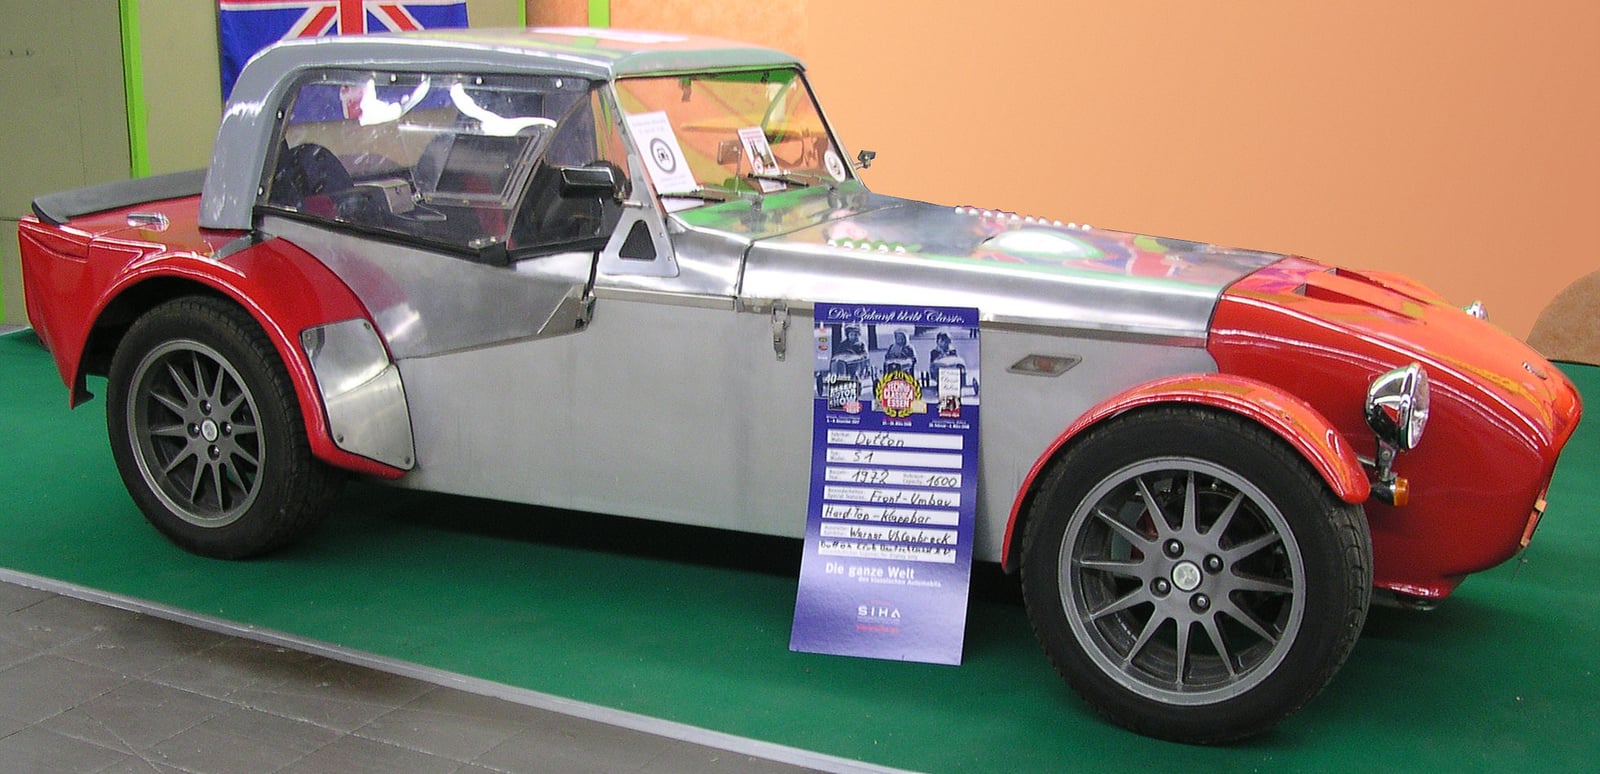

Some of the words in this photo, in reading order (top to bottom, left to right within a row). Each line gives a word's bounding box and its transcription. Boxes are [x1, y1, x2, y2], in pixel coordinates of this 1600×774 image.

[827, 307, 850, 320] Die
[854, 307, 894, 323] Zukunft
[897, 311, 922, 321] bleibt
[924, 310, 965, 324] Classic.
[887, 398, 911, 409] ESSEN
[855, 431, 905, 448] Dutton
[851, 469, 889, 484] 1972
[926, 475, 958, 487] 1600
[850, 526, 883, 540] Werner
[825, 562, 845, 575] Die
[848, 565, 884, 580] ganze
[887, 566, 915, 580] Welt
[857, 605, 901, 618] SIHA
